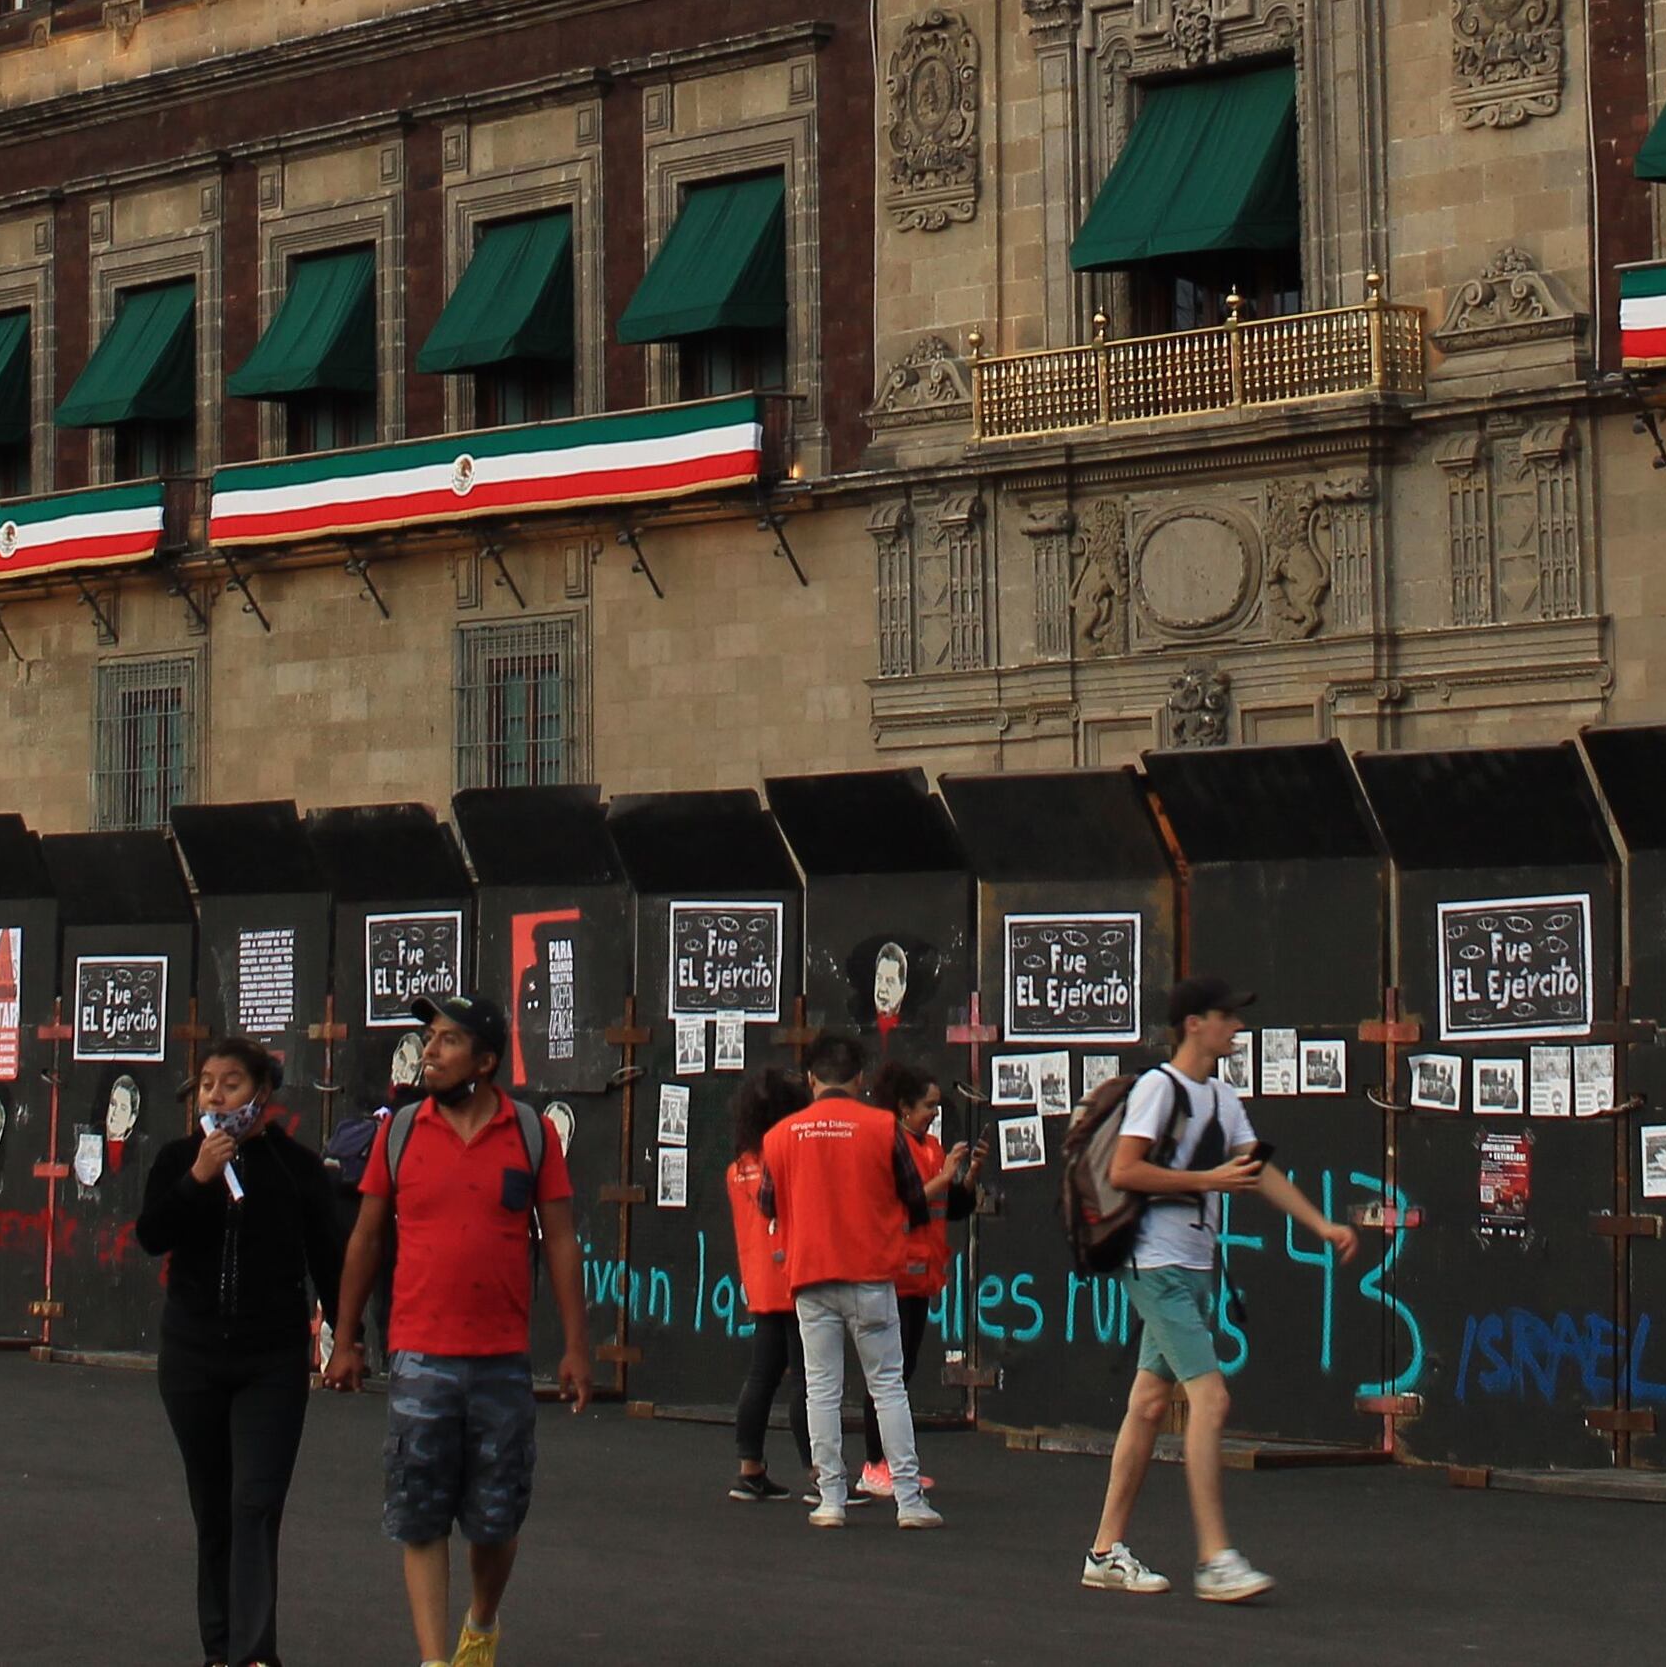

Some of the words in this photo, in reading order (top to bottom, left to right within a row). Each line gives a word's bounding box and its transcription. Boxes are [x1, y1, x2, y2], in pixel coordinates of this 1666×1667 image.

[398, 940, 424, 966] Fue
[549, 939, 573, 960] PARA
[707, 929, 738, 957] Fue
[1050, 943, 1087, 974] Fue
[1491, 932, 1533, 964] Fue
[106, 980, 131, 1005] Fue
[374, 967, 391, 996] EL
[396, 961, 453, 1002] Ejército
[679, 957, 699, 987] EL
[704, 954, 772, 996] Ejército
[1452, 967, 1481, 1002] EL
[1487, 956, 1579, 1009] Ejército
[1016, 975, 1040, 1007] EL
[1047, 970, 1128, 1016] Ejército
[82, 1005, 99, 1032] EL
[103, 1001, 157, 1039] Ejército
[576, 1233, 671, 1325] ivan
